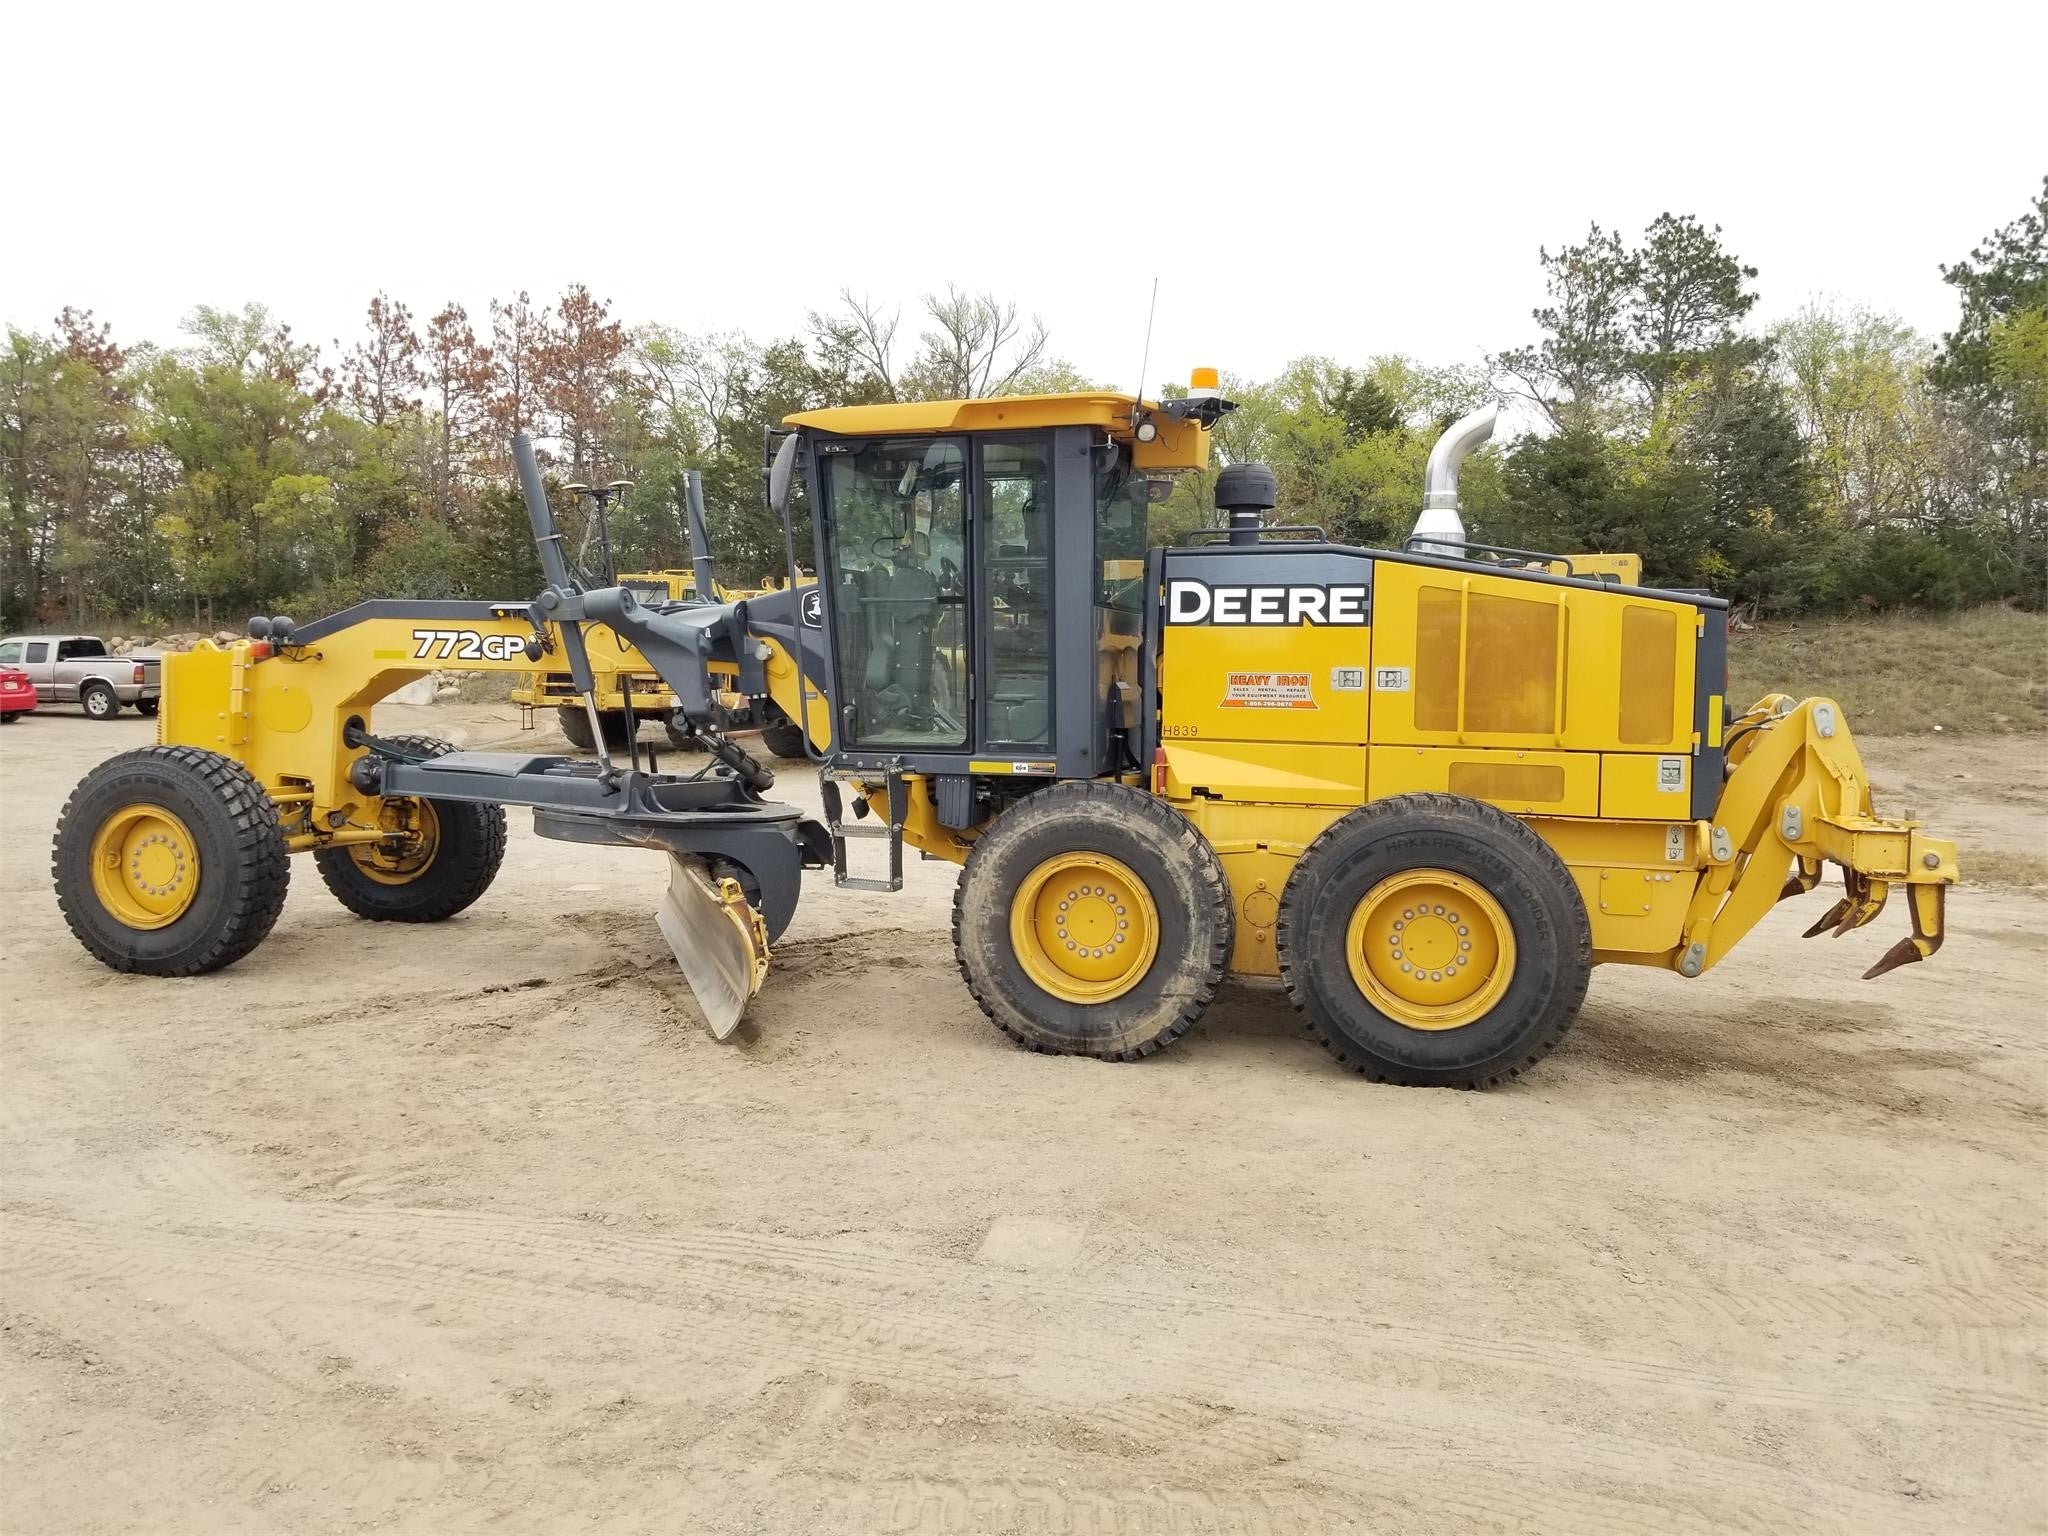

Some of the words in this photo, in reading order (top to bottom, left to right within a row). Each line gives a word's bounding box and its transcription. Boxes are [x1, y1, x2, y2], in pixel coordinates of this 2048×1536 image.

[1168, 580, 1366, 624] DEERE
[413, 629, 526, 660] 772GP
[1230, 674, 1271, 686] HEAVY
[1276, 675, 1309, 687] IRON
[1163, 725, 1198, 736] H839
